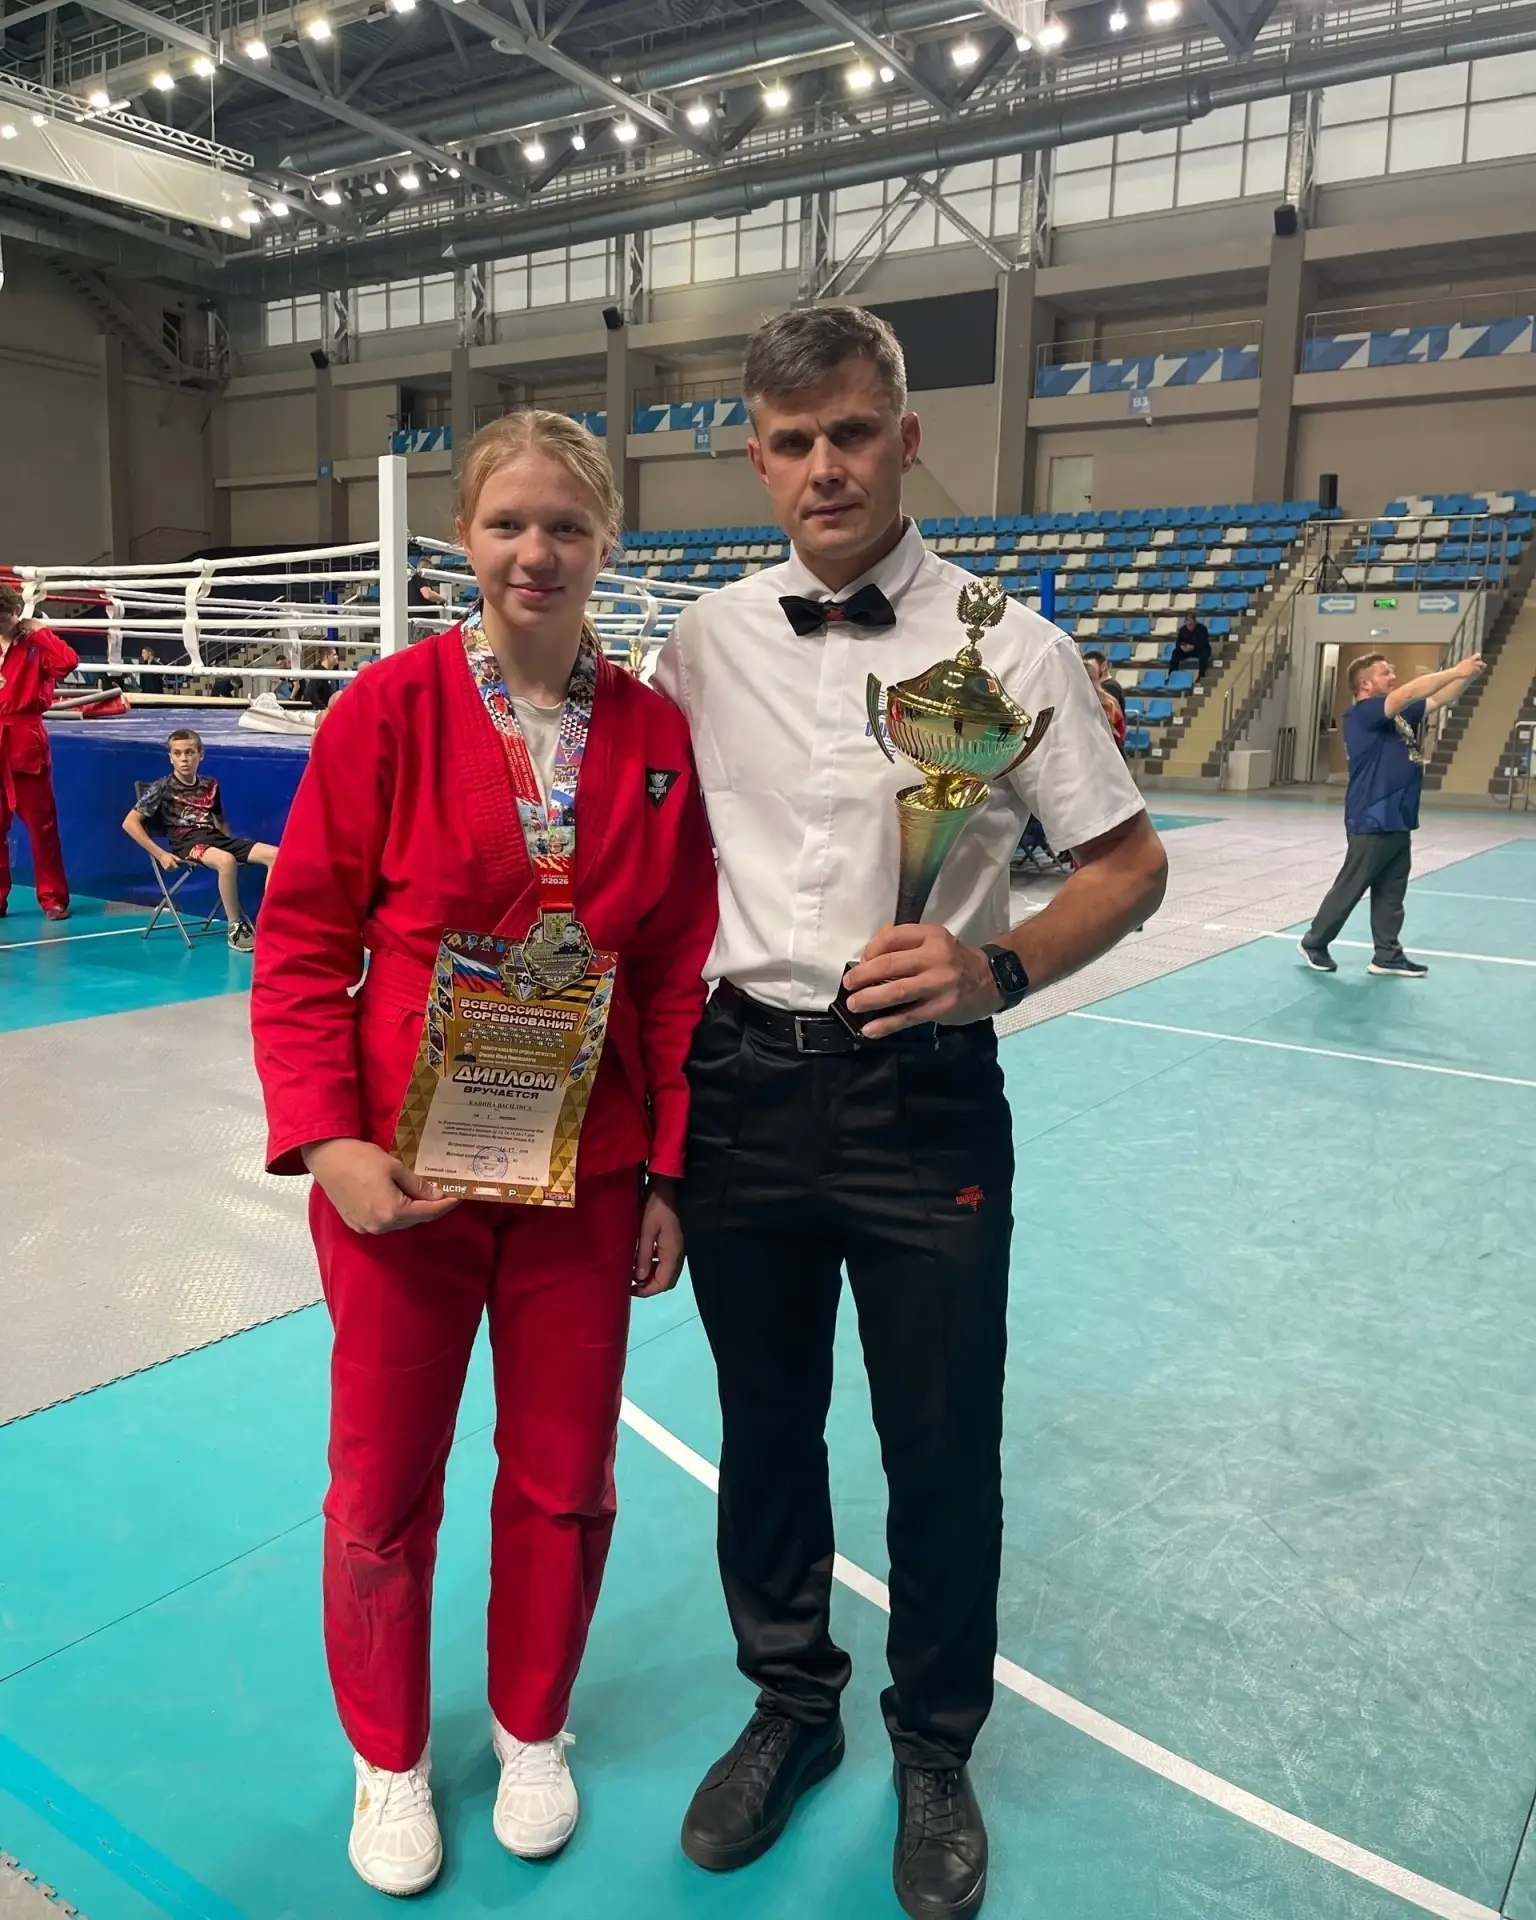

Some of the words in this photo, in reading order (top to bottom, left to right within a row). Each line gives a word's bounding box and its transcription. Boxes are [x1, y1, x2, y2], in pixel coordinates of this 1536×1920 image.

[460, 998, 579, 1021] ВСЕРОССИЙСКИЕ
[462, 1010, 574, 1031] СОРЕВНОВАНИЯ
[454, 1064, 556, 1089] ДИПЛОМ
[464, 1086, 540, 1100] ВРУЧАЕТСЯ
